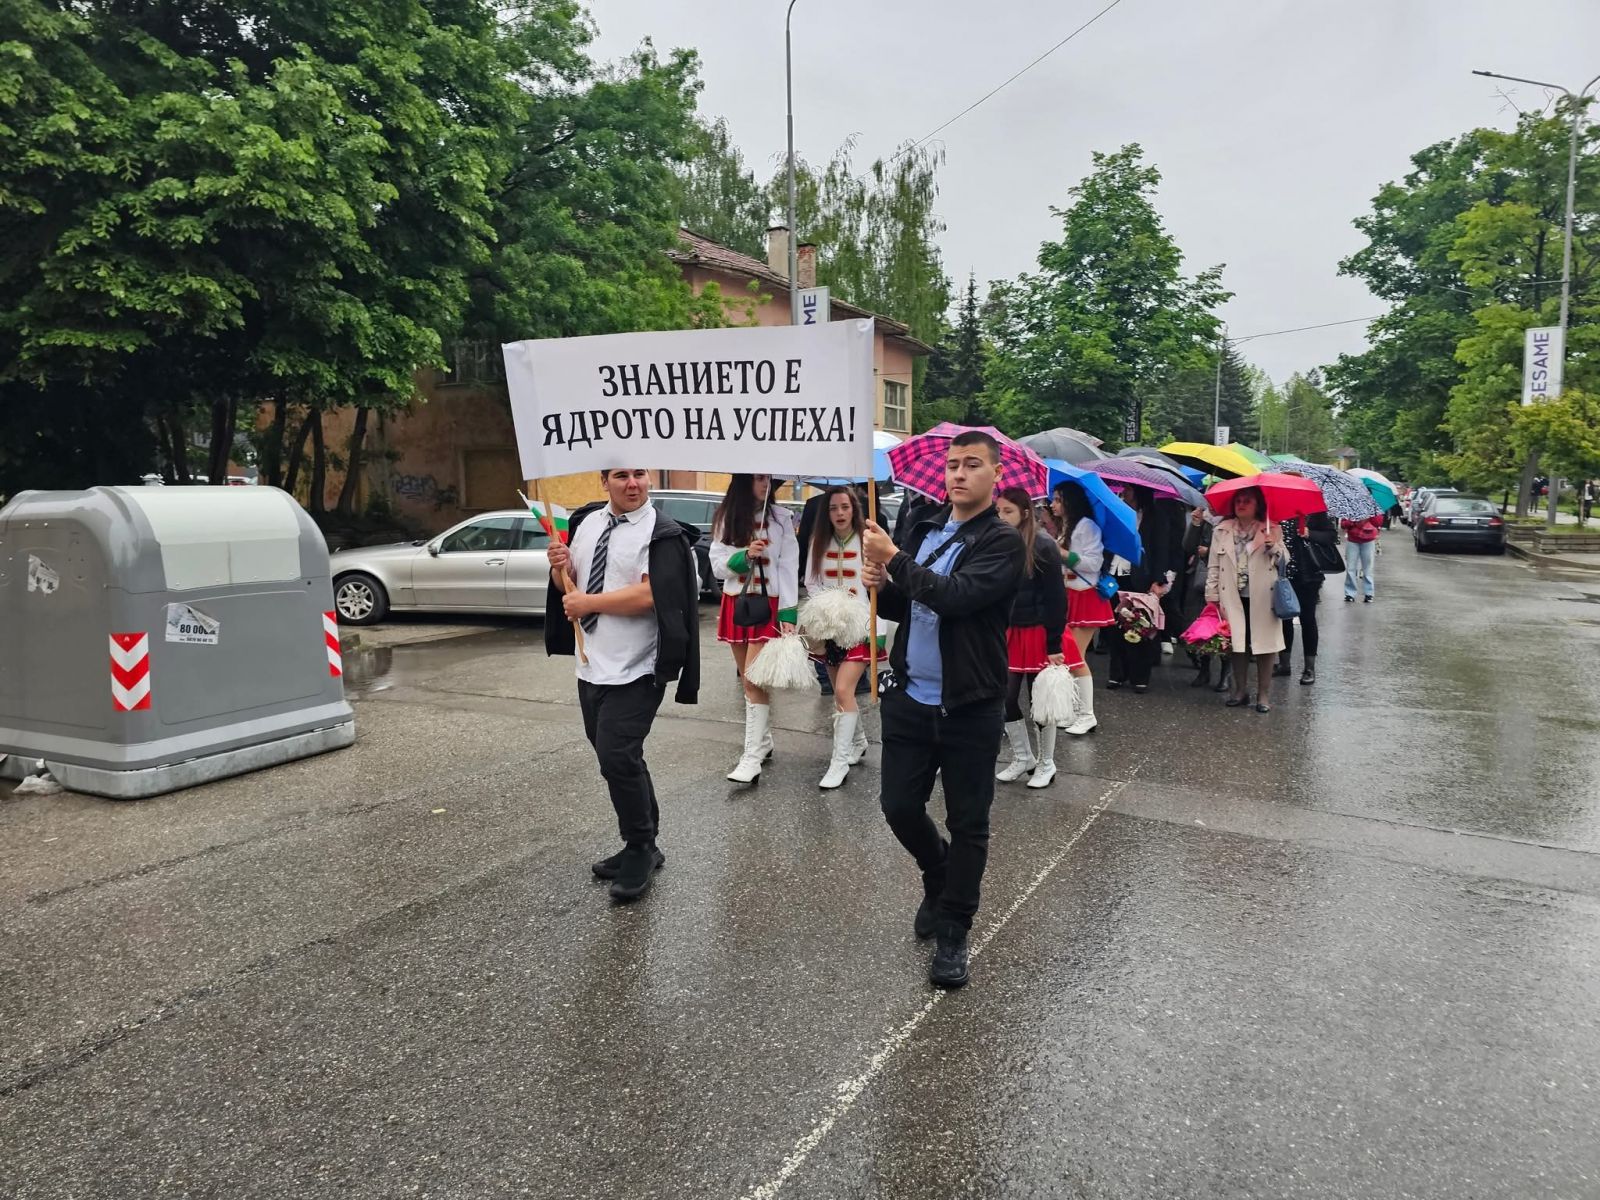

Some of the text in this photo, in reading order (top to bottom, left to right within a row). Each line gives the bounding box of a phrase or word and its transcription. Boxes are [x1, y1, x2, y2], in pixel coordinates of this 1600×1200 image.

[803, 295, 816, 325] ME
[599, 359, 802, 397] ЗНАНИЕТО Е
[542, 406, 856, 451] ЯДРОТО НА УСПЕХА!
[180, 624, 191, 634] 80
